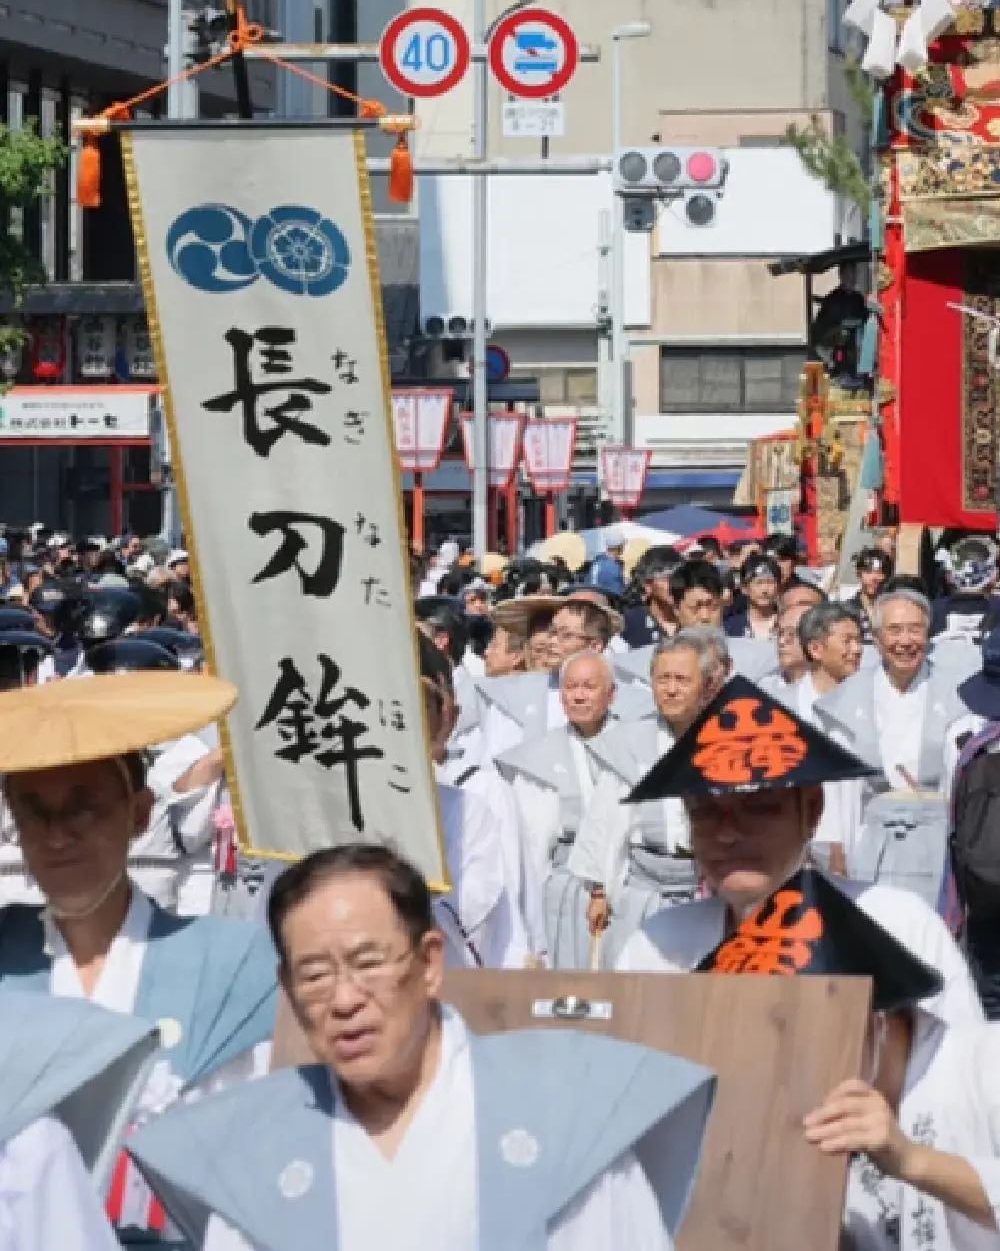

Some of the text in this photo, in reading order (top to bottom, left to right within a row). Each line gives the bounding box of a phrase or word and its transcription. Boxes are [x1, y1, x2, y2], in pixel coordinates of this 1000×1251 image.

[400, 32, 452, 72] 40
[199, 325, 384, 832] 長刀鉾
